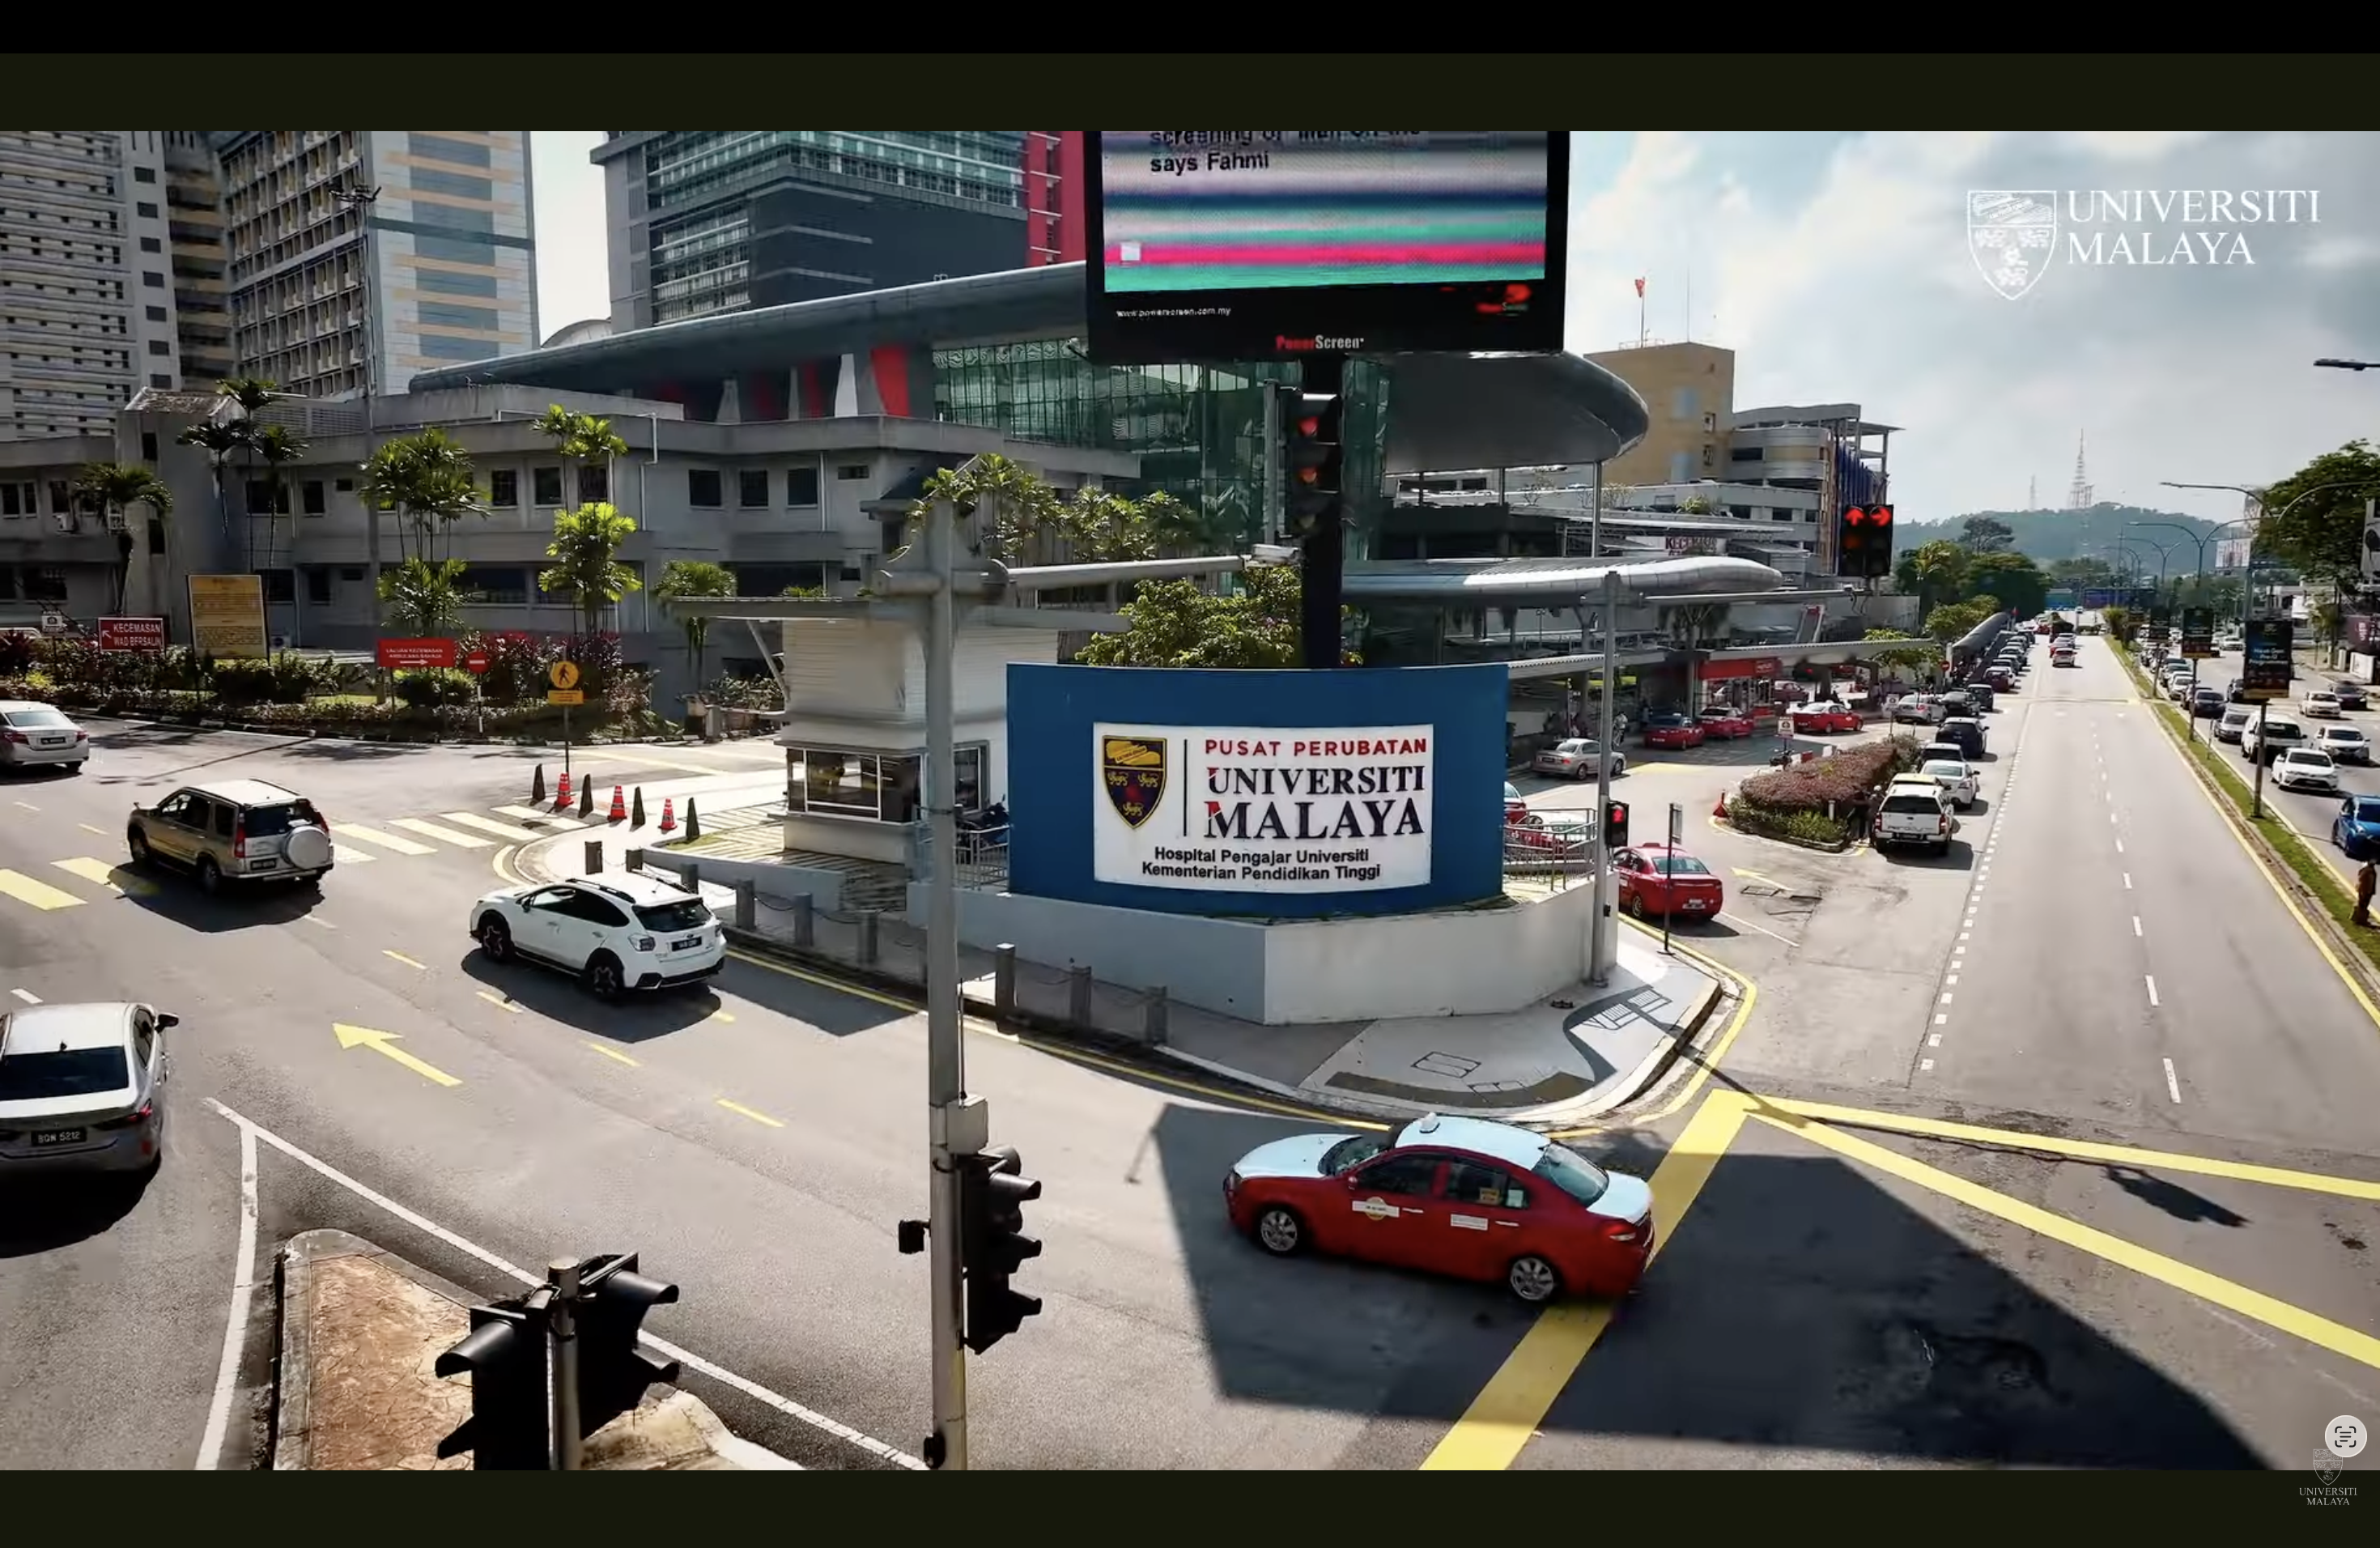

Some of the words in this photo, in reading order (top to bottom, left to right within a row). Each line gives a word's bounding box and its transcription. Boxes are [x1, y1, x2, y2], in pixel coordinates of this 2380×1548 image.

[1150, 156, 1198, 176] says
[1207, 151, 1269, 171] Fahmi
[113, 623, 161, 633] KECEMASAN
[1205, 740, 1281, 756] PUSAT
[1294, 738, 1427, 756] PERUBATAN
[1206, 765, 1426, 796] UNIVERSITI
[1203, 797, 1425, 840] MALAYA
[1154, 846, 1216, 865] Hospital
[1220, 849, 1293, 867] Pengajar
[1295, 848, 1370, 864] Universiti
[1141, 861, 1239, 880] Kementerian
[1241, 865, 1330, 882] Pendidikan
[1335, 864, 1381, 882] Tinggi
